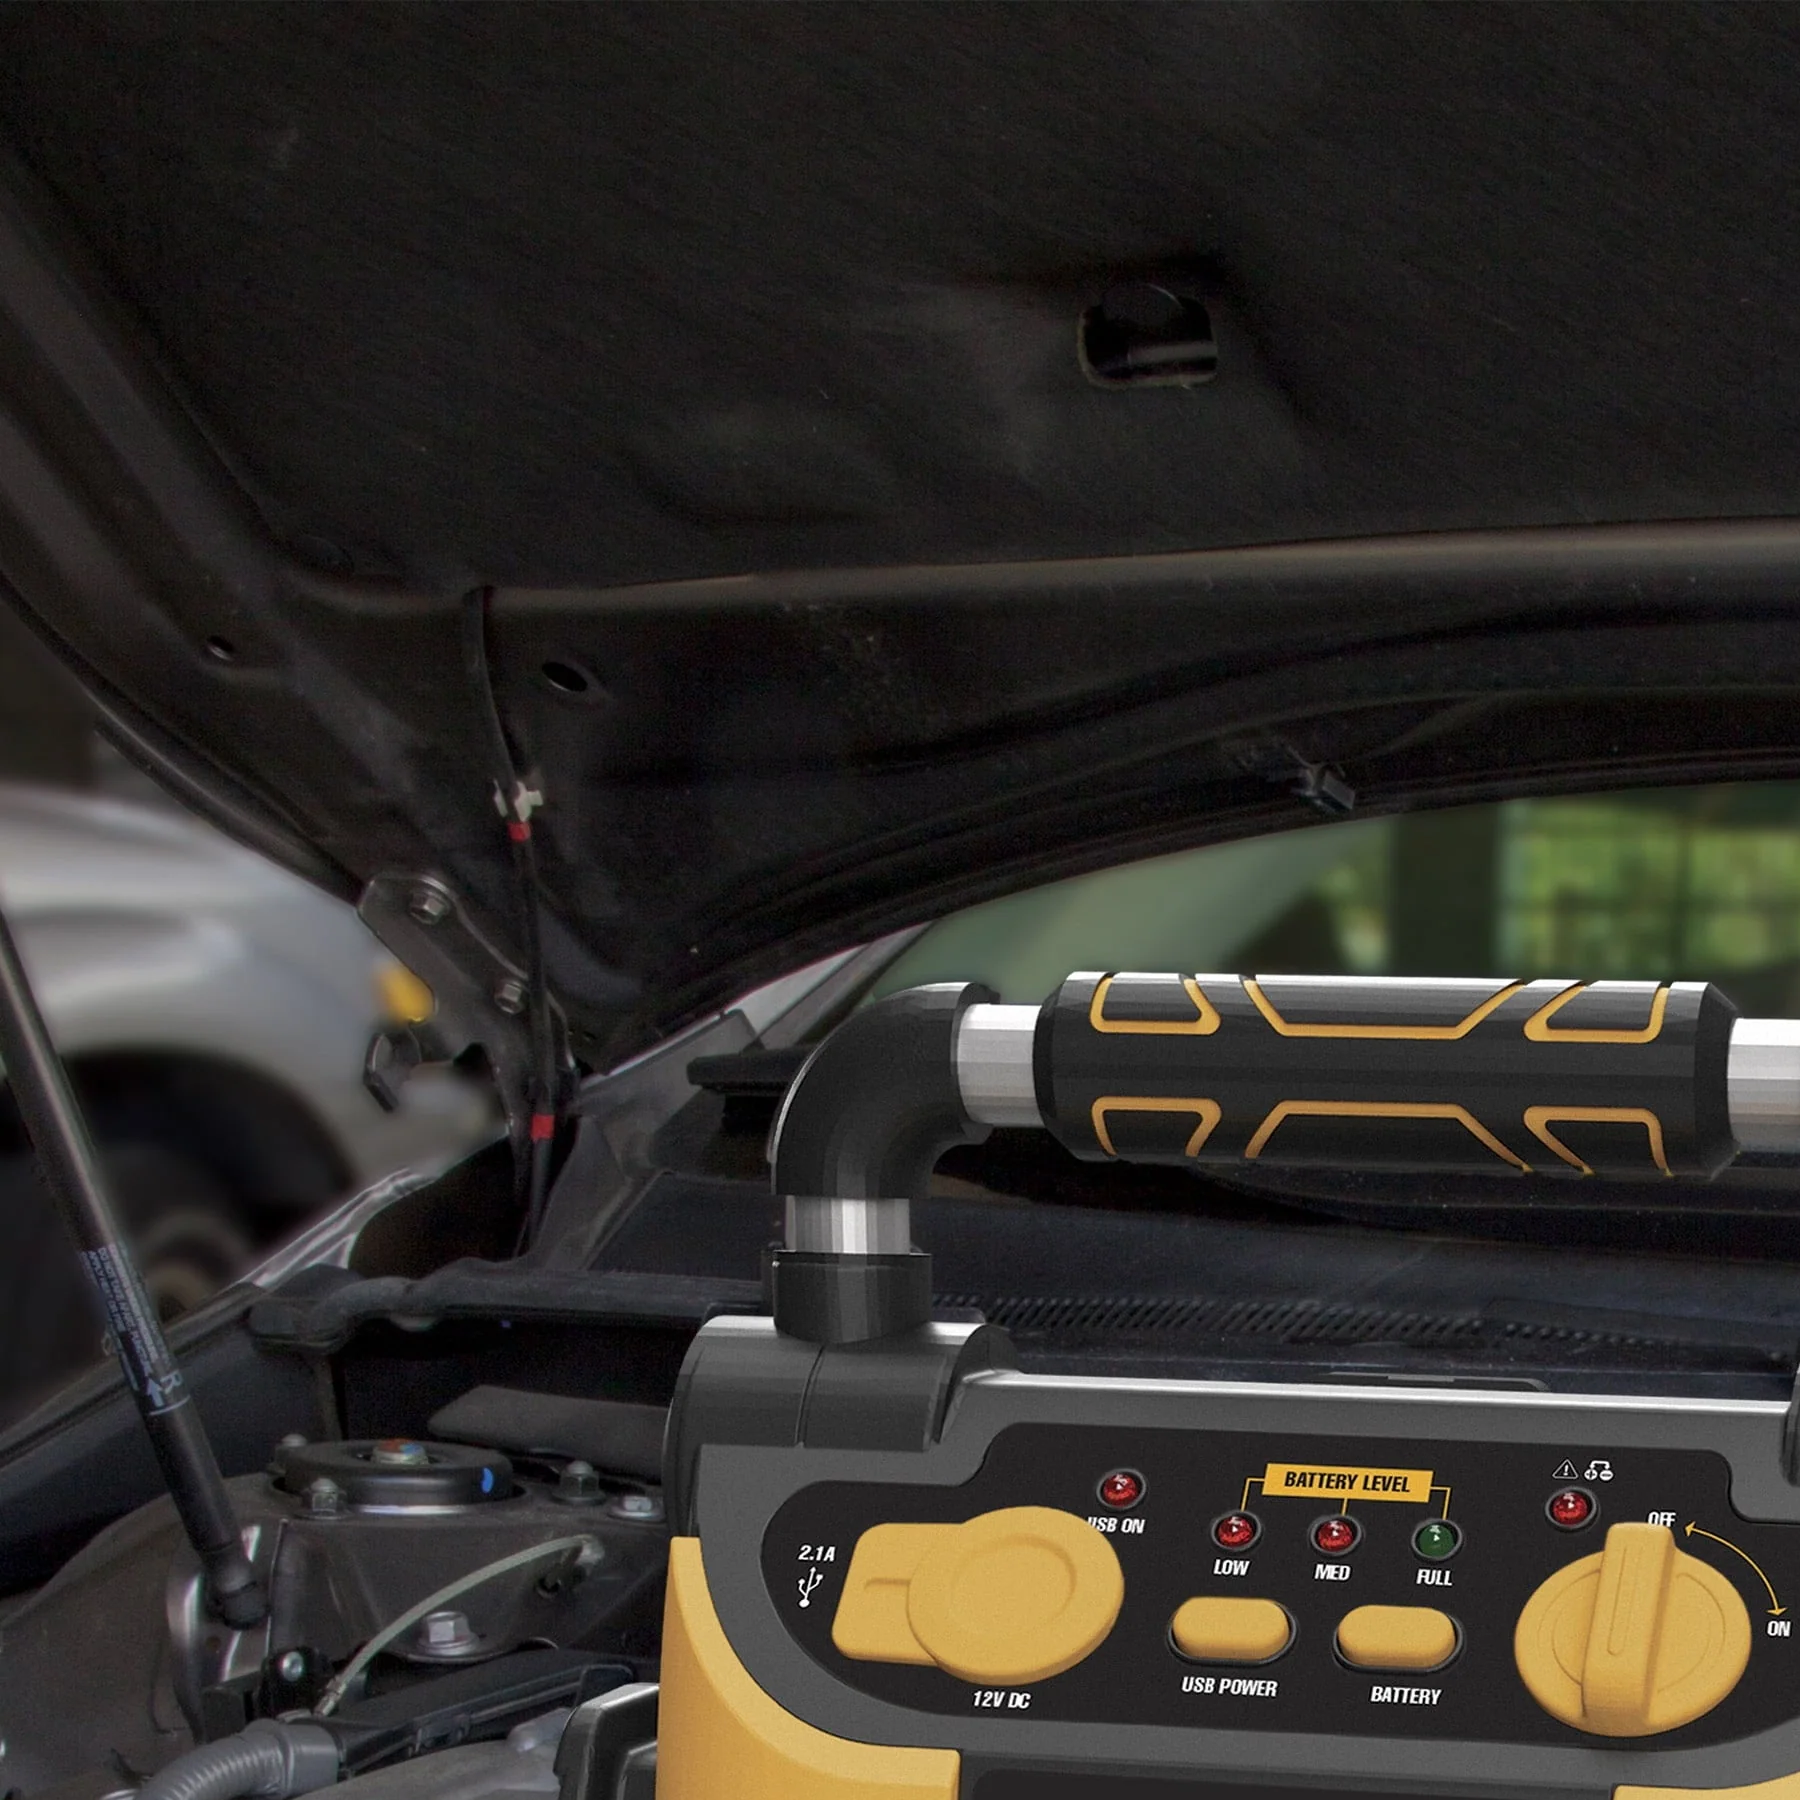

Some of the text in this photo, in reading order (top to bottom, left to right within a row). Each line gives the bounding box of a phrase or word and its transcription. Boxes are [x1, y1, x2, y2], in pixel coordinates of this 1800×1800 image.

[1283, 1470, 1411, 1493] BATTERY LEVEL
[1120, 1517, 1146, 1535] ON
[1647, 1511, 1677, 1528] OFF
[798, 1544, 836, 1563] 2.1A
[1212, 1558, 1251, 1577] LOW
[1313, 1563, 1351, 1582] MED
[1415, 1568, 1454, 1587] FULL
[1766, 1619, 1792, 1639] ON
[1181, 1676, 1279, 1699] USB POWER
[1369, 1685, 1442, 1707] BATTERY
[972, 1690, 1032, 1710] 12V DC
